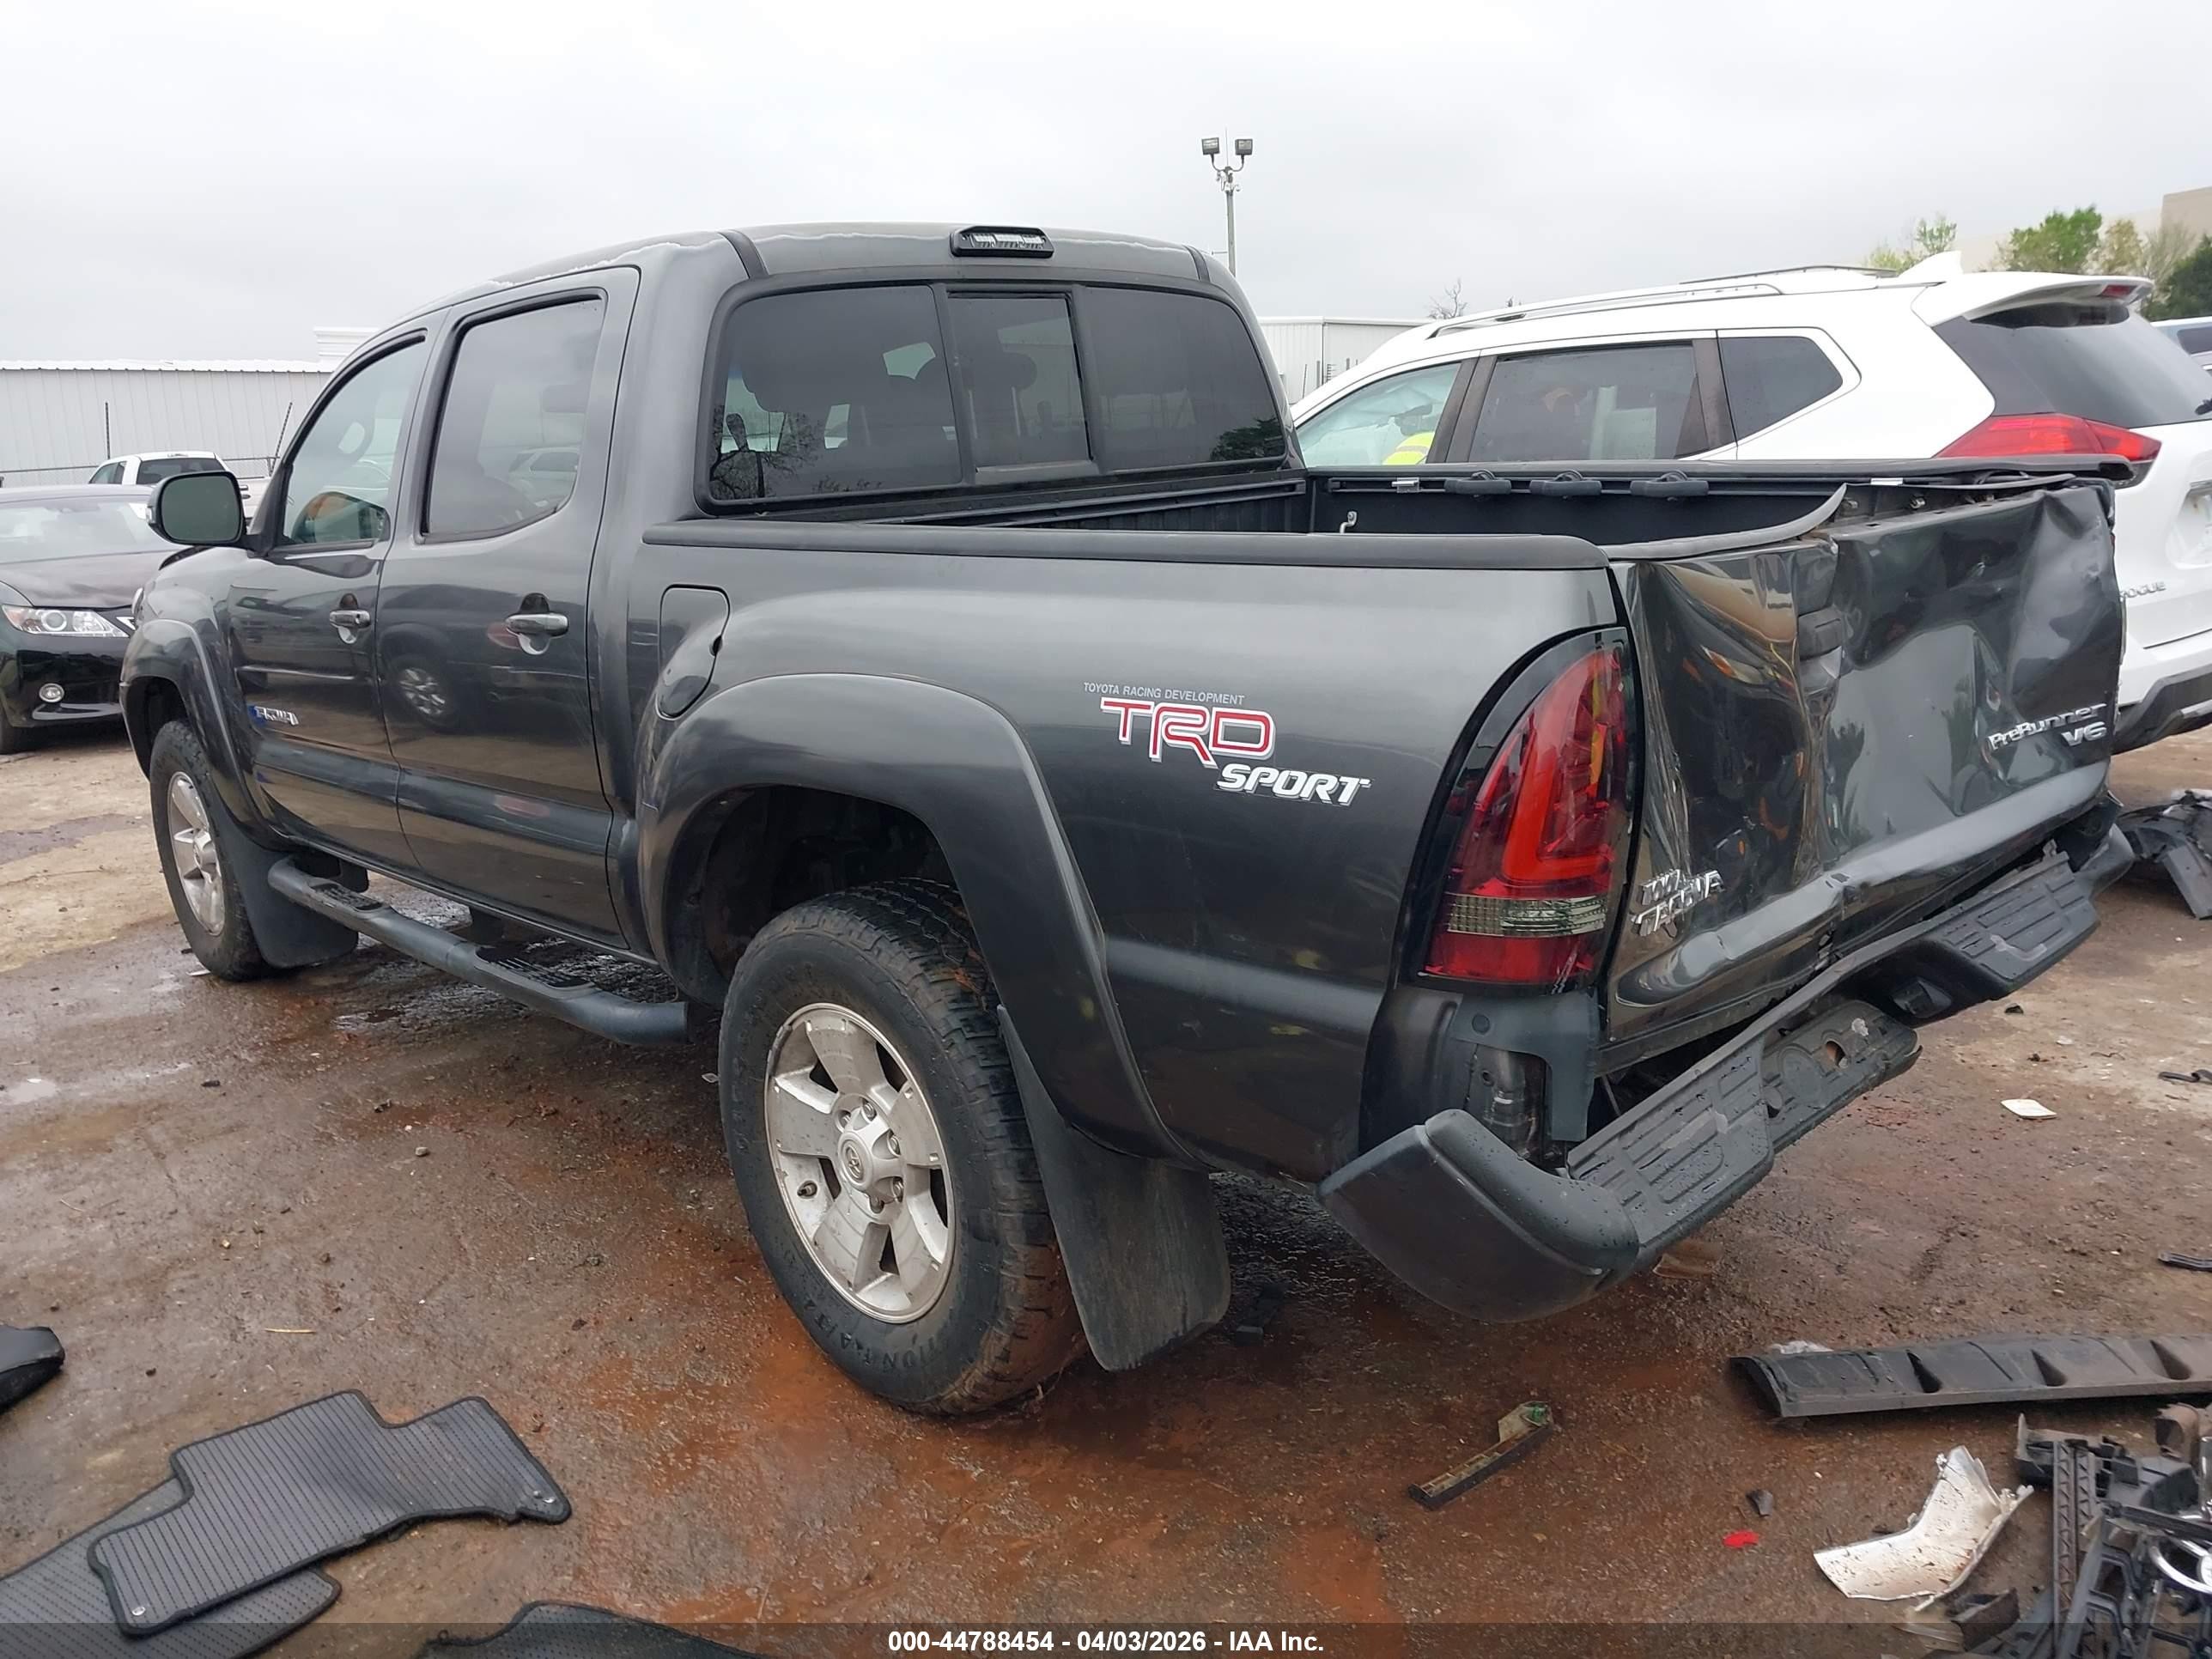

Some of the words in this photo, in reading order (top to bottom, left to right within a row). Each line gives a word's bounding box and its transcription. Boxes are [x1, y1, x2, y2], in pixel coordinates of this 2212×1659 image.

[1084, 682, 1120, 695] TOYOTA
[1122, 685, 1162, 698] RACING
[1164, 689, 1245, 705] DEVELOPMENT
[1100, 696, 1276, 769] TRD
[1987, 702, 2107, 750] PreRunner
[2061, 721, 2107, 746] V6
[1217, 763, 1372, 806] SPORT
